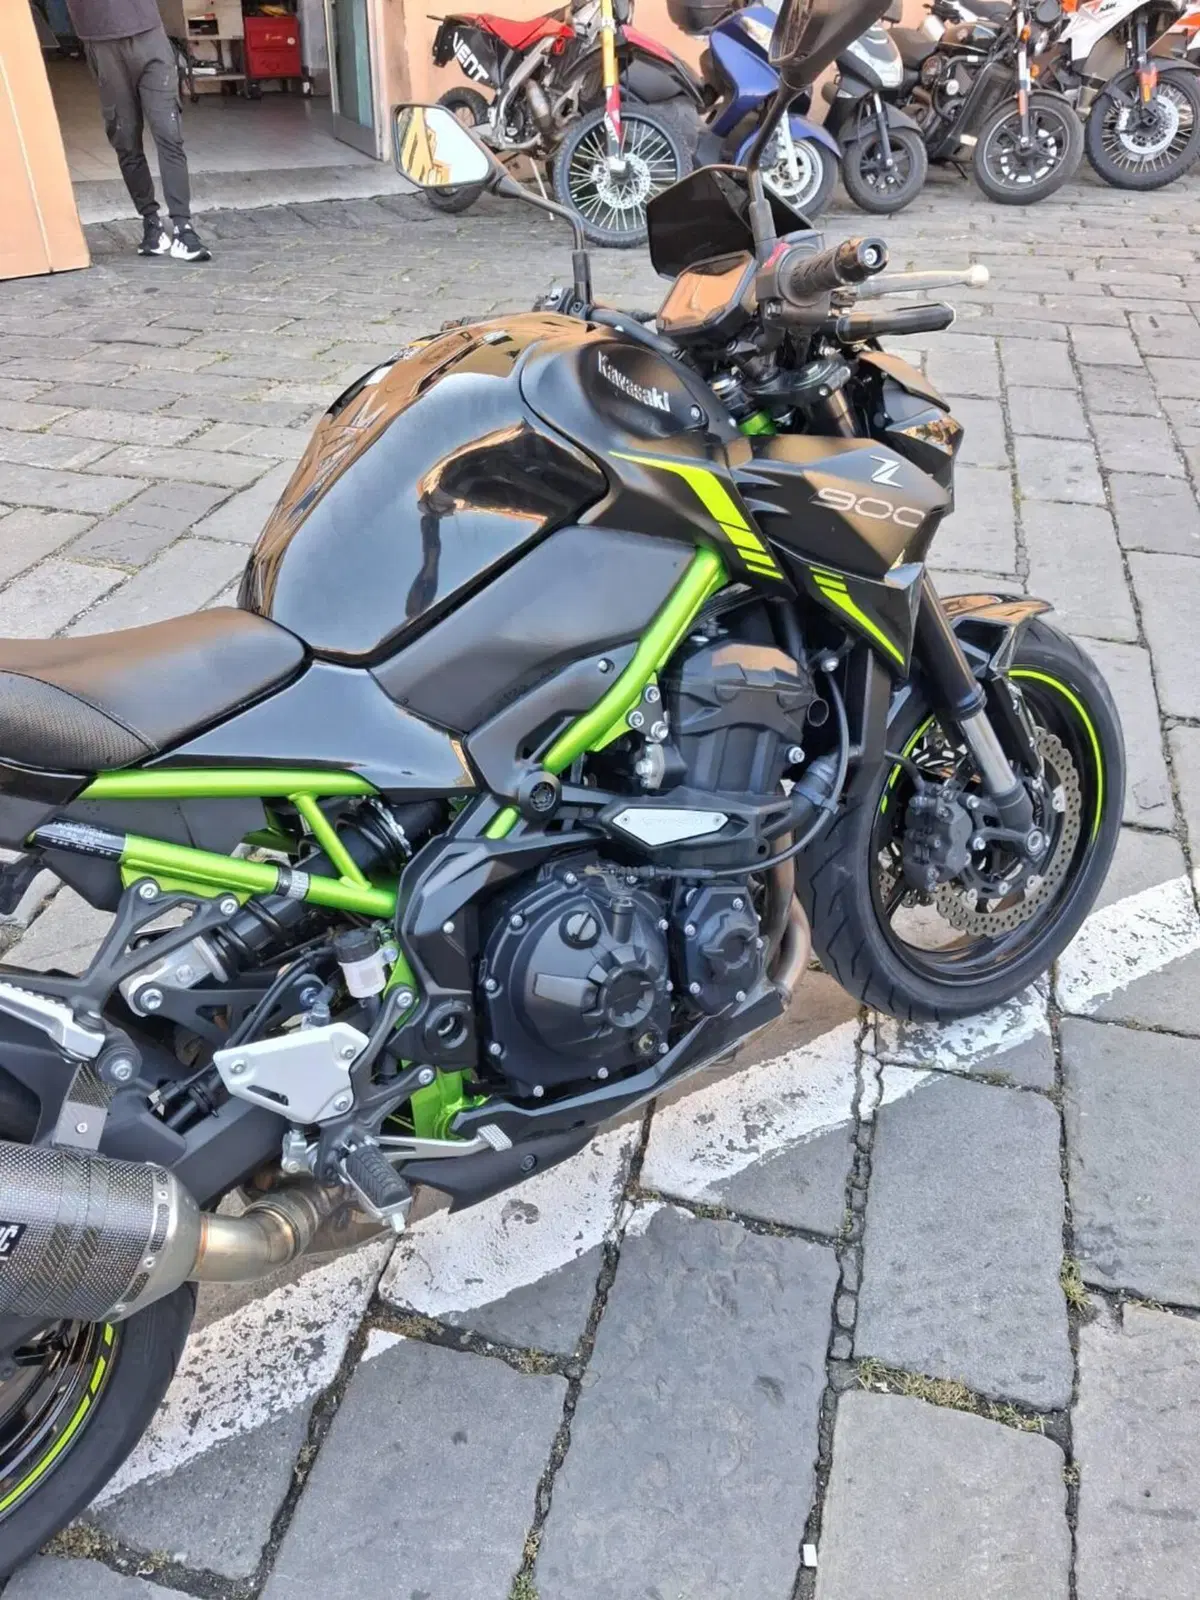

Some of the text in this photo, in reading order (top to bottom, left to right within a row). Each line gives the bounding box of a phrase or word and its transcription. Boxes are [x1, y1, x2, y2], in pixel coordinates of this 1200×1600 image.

[453, 31, 489, 82] VENT
[598, 350, 671, 412] Kawasaki
[808, 487, 926, 529] 900
